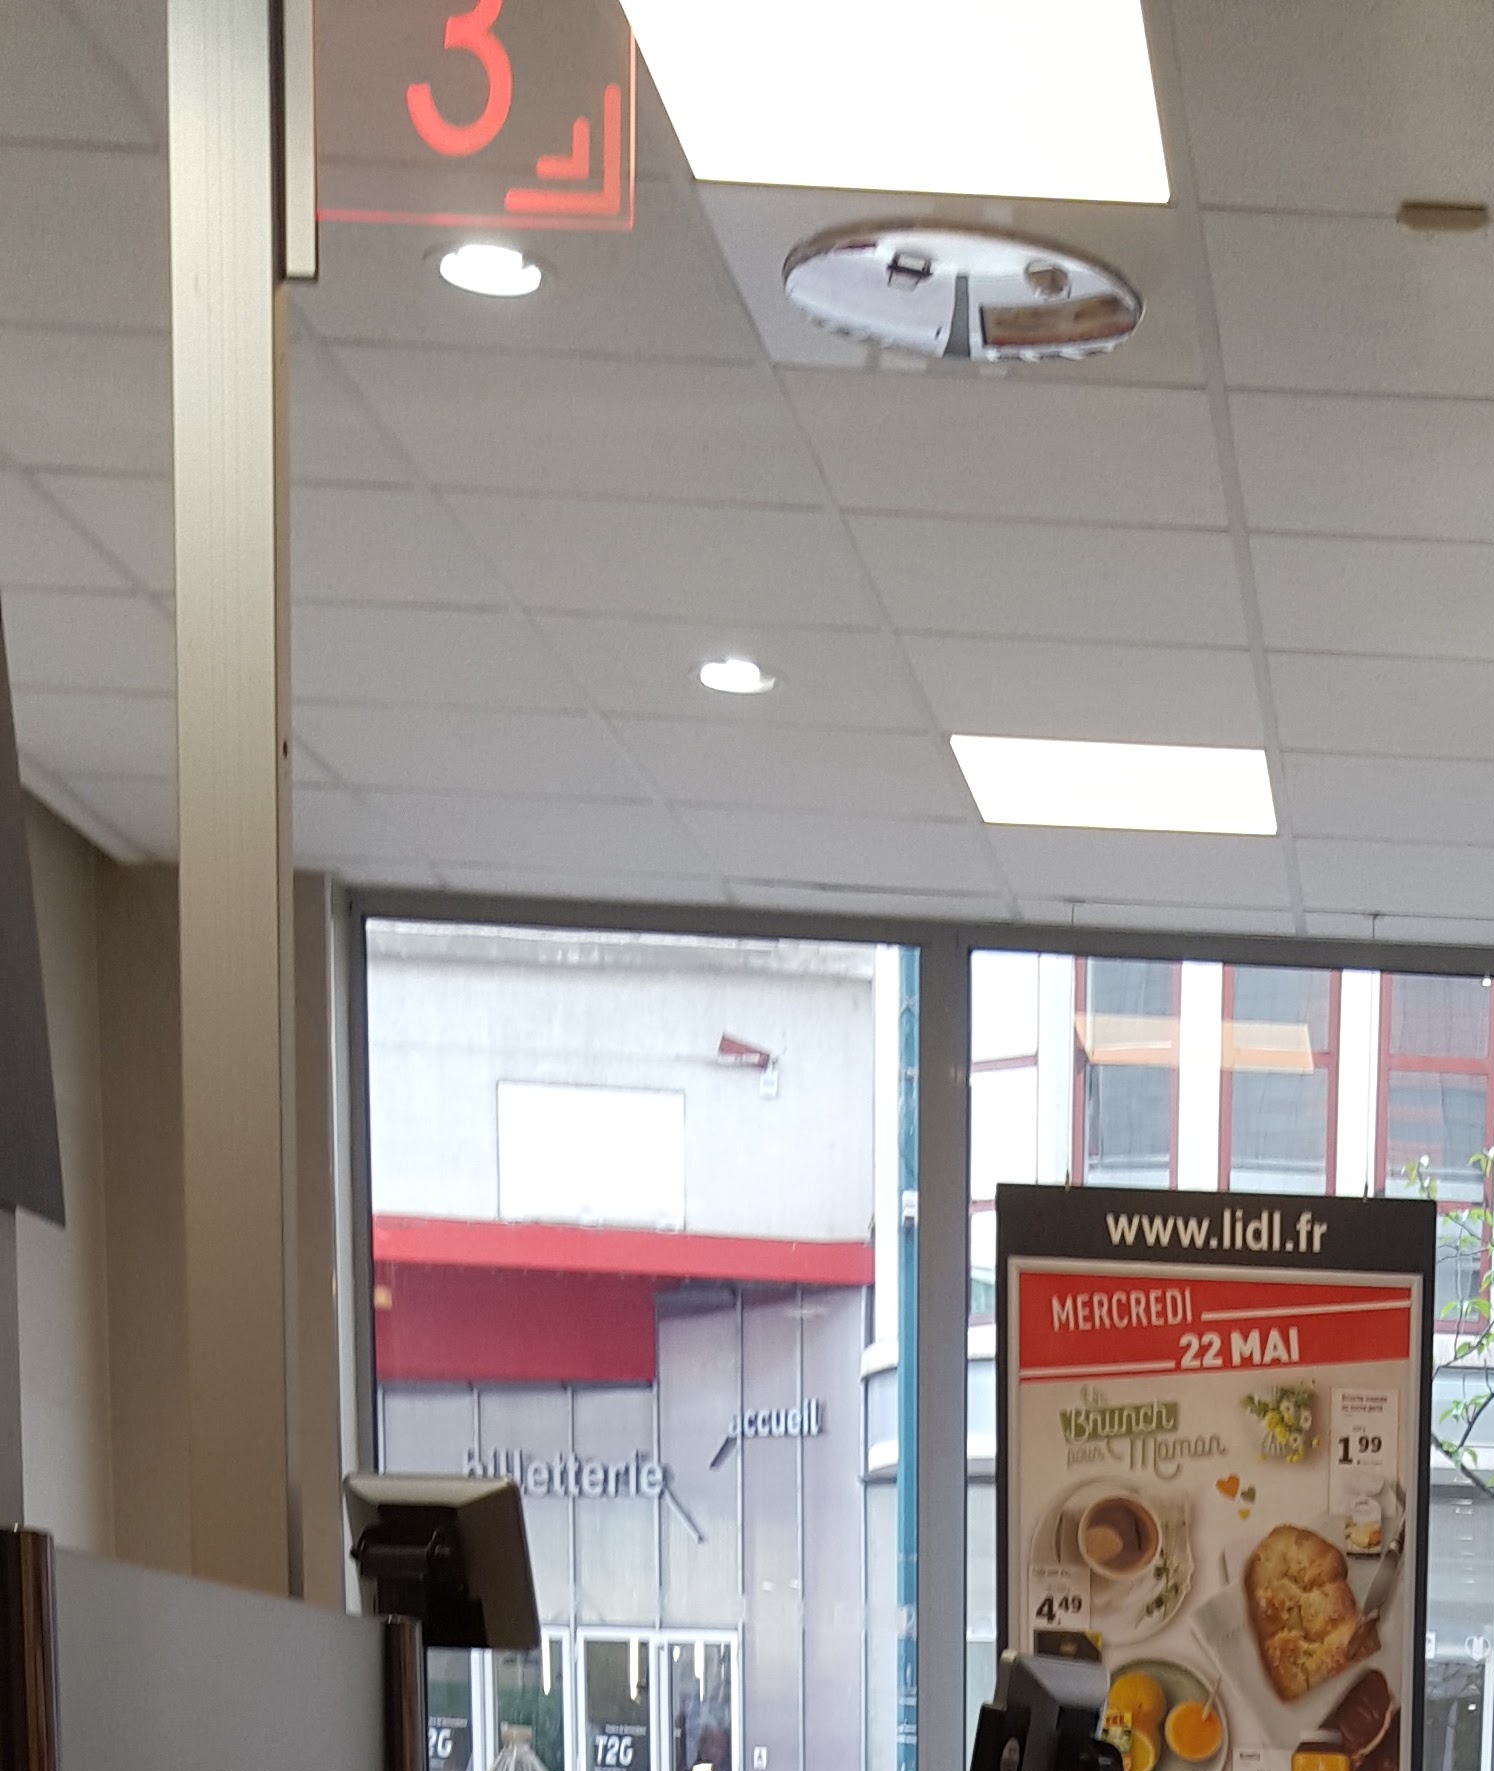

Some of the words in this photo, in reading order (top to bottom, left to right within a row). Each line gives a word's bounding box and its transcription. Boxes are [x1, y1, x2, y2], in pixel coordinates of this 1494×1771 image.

[405, 0, 514, 157] 3
[1106, 1207, 1328, 1253] www.lidl.fr
[1051, 1287, 1193, 1332] MERCREDI
[1179, 1331, 1224, 1370] 22
[1230, 1326, 1299, 1367] MAI
[728, 1397, 823, 1437] accueil
[1064, 1399, 1175, 1446] Brunch
